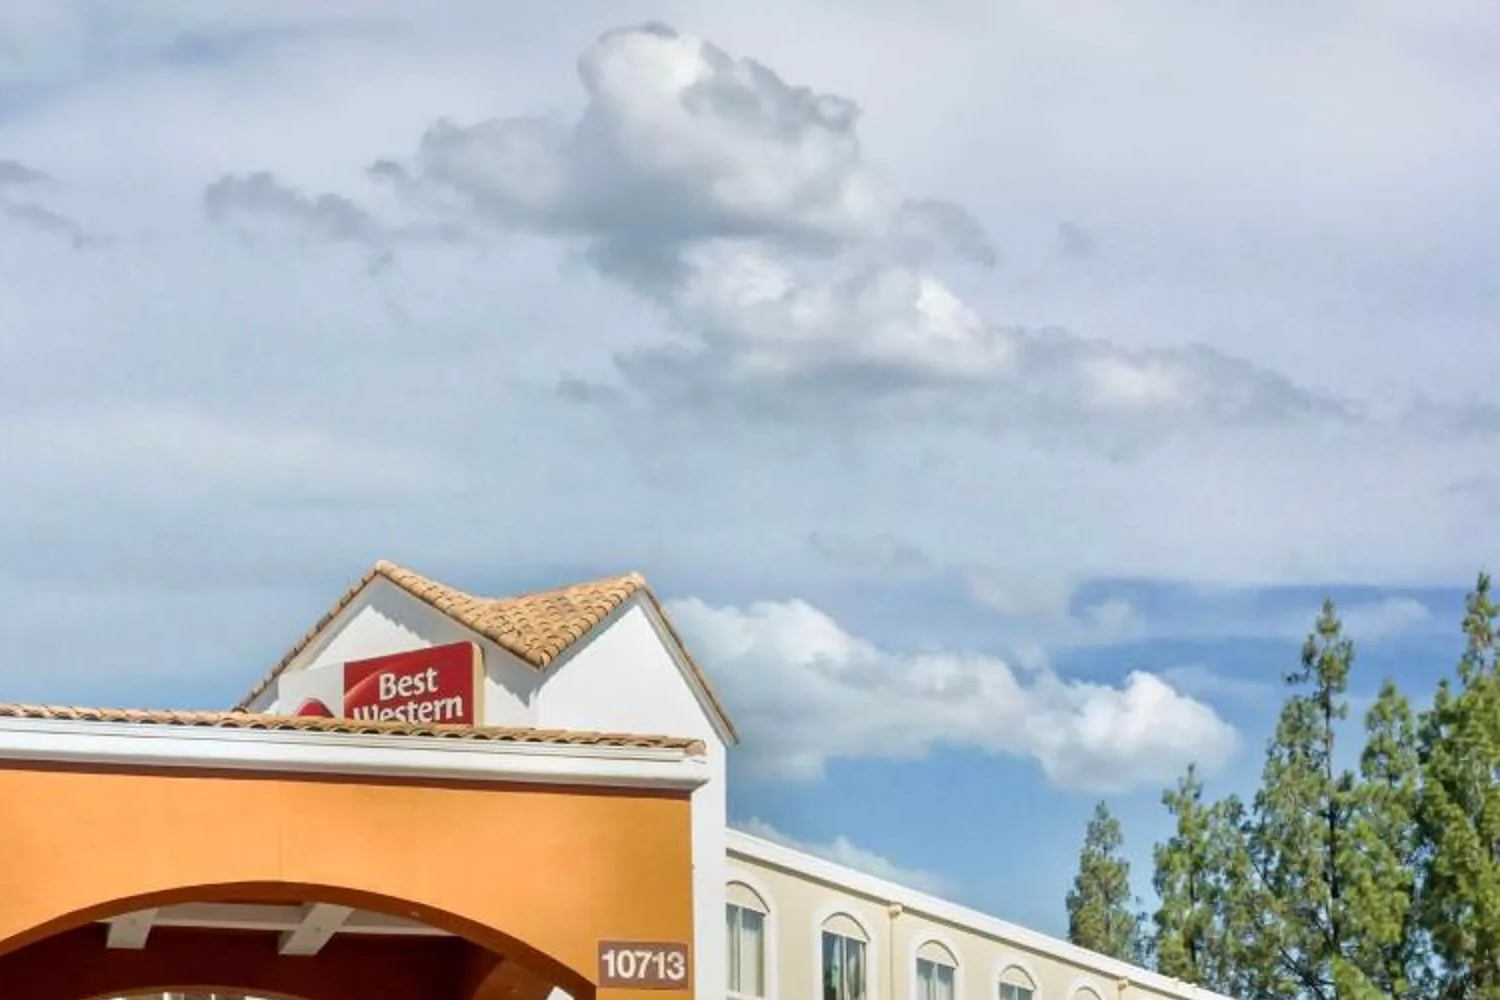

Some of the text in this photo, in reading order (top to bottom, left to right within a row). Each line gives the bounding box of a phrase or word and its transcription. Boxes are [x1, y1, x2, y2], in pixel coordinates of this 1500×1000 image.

[379, 667, 438, 700] Best
[353, 696, 463, 725] Western
[602, 949, 685, 980] 10713
